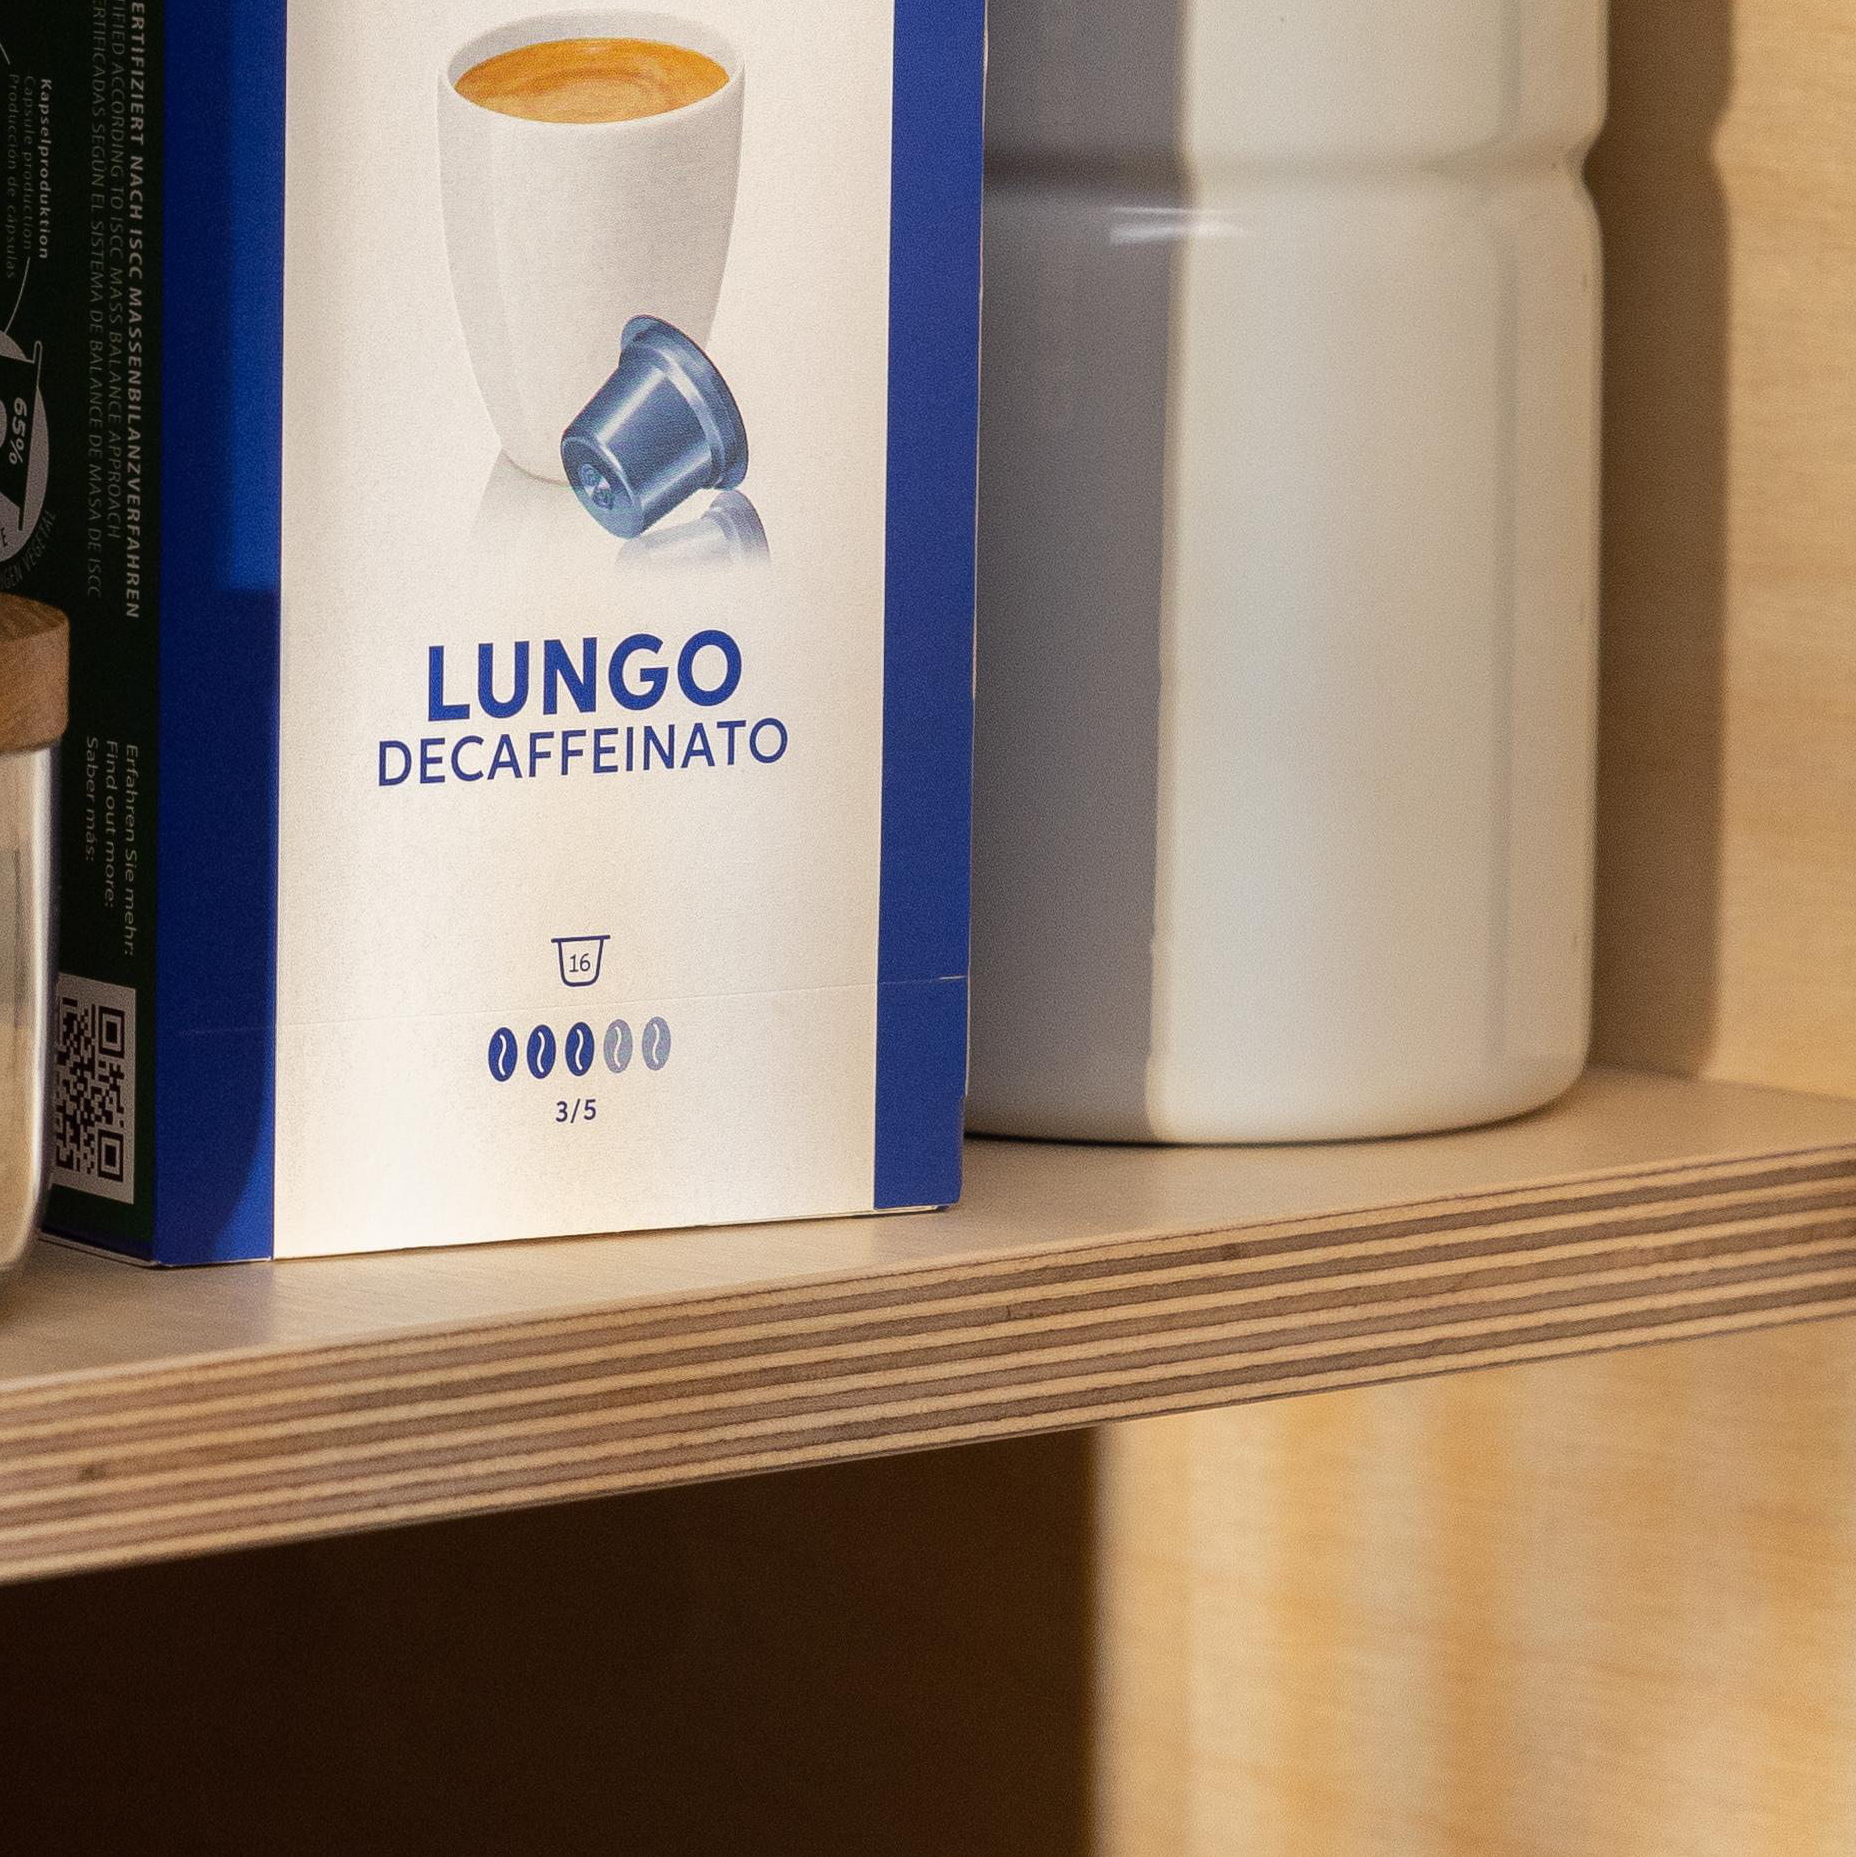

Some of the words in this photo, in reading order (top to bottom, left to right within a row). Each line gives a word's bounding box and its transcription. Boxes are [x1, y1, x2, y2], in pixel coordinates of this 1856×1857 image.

[6, 73, 20, 170] Producción
[21, 74, 36, 145] Capsule
[110, 62, 125, 178] ACCORDING
[6, 176, 19, 198] de
[20, 151, 35, 250] production
[36, 77, 52, 260] Kapselproduktion
[110, 186, 124, 210] TO
[129, 155, 144, 220] NACH
[91, 193, 105, 214] EL
[4, 204, 19, 280] cápsulas
[90, 220, 105, 303] SISTEMA
[109, 216, 124, 260] ISCC
[129, 228, 143, 280] ISCC
[89, 310, 104, 333] DE
[109, 266, 123, 324] MASS
[88, 339, 103, 428] BALANCE
[108, 331, 123, 423] BALANCE
[7, 396, 27, 466] 65%
[88, 432, 102, 457] DE
[126, 287, 143, 618] MASSENBILANZVERFAHREN
[87, 462, 102, 520] MASA
[107, 429, 122, 538] APPROACH
[87, 526, 101, 550] DE
[87, 556, 101, 598] ISCC
[427, 629, 744, 722] LUNGO
[85, 736, 99, 802] Saber
[105, 740, 118, 790] Find
[378, 716, 788, 787] DECAFFEINATO
[104, 795, 117, 835] out
[124, 743, 139, 842] Erfahren
[84, 808, 98, 862] más:
[124, 848, 138, 882] Sie
[103, 840, 115, 908] more:
[123, 888, 137, 957] mehr:
[567, 952, 592, 975] 16
[554, 1097, 598, 1124] 3/5
